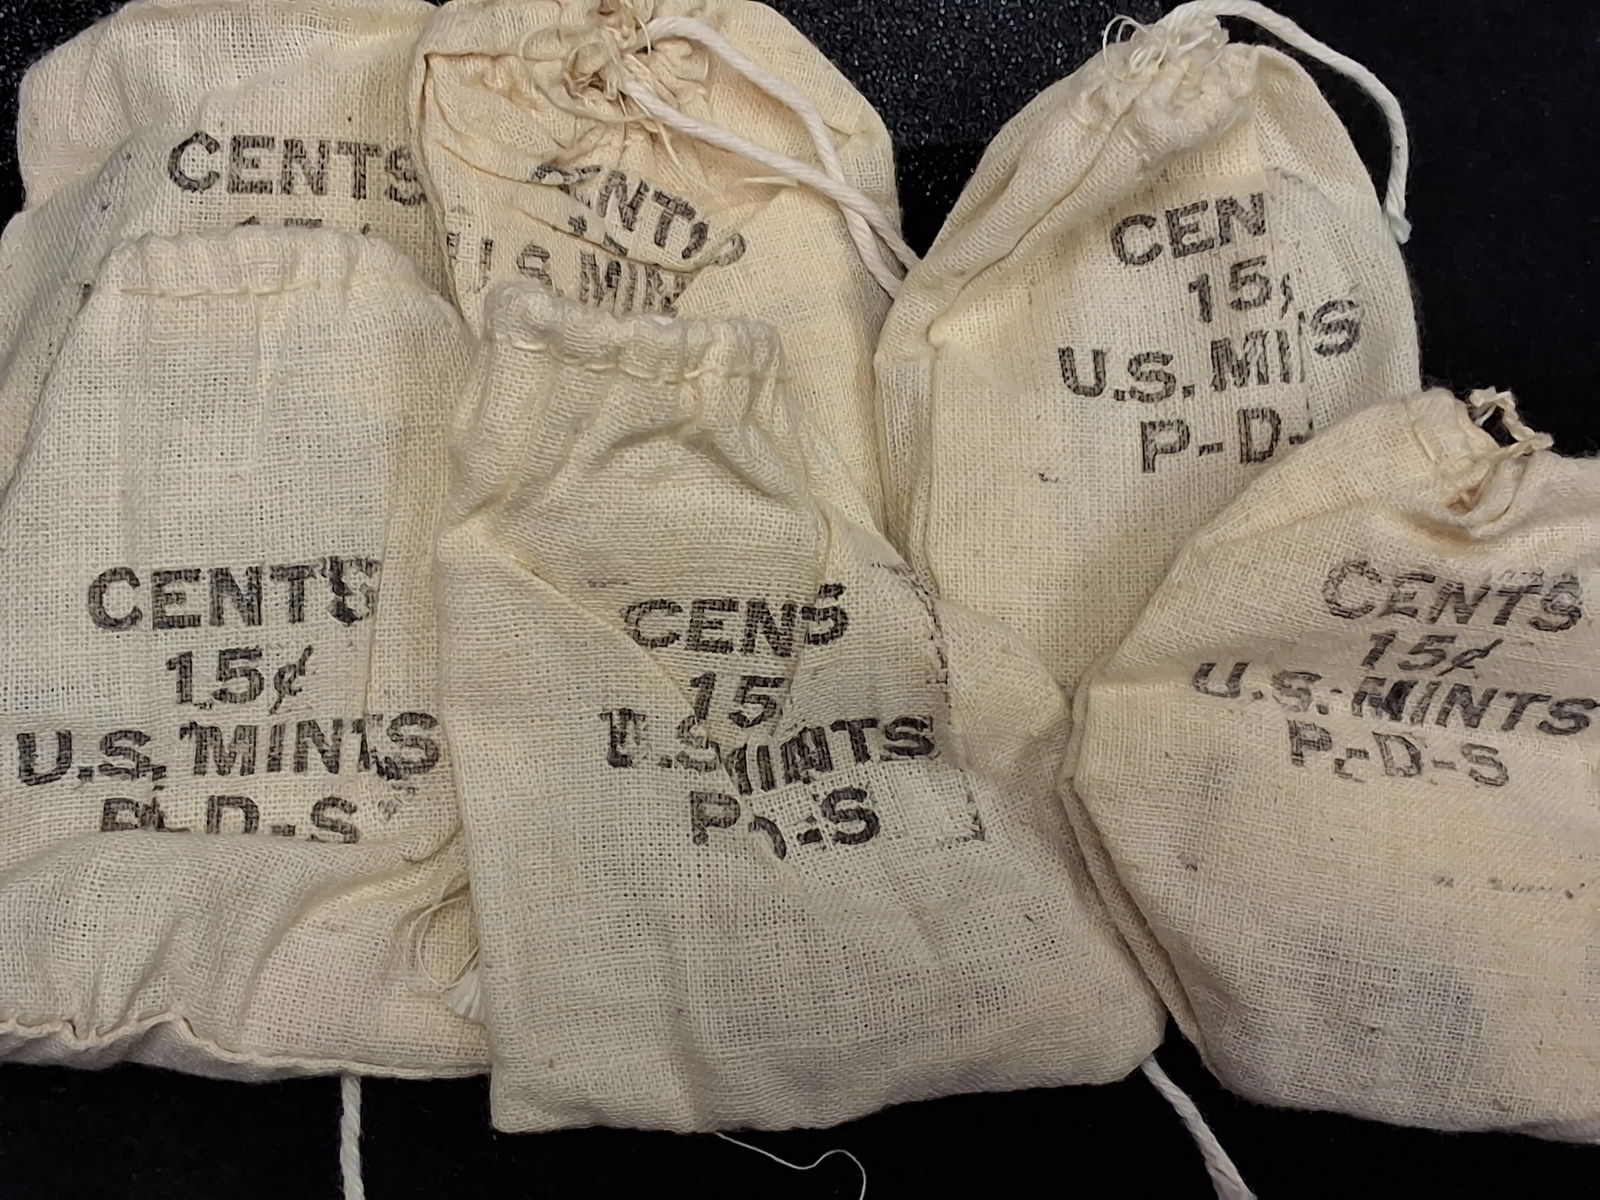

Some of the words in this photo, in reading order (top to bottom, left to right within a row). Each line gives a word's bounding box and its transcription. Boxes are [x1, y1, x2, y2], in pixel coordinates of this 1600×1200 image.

[1057, 347, 1195, 403] U.S.
[87, 555, 382, 632] CENTS
[1322, 558, 1584, 633] CENTS
[165, 644, 314, 715] 15¢
[1360, 629, 1504, 678] 15¢
[1350, 675, 1600, 736] MINTS
[16, 729, 167, 787] U.S.
[179, 711, 440, 782] MINTS
